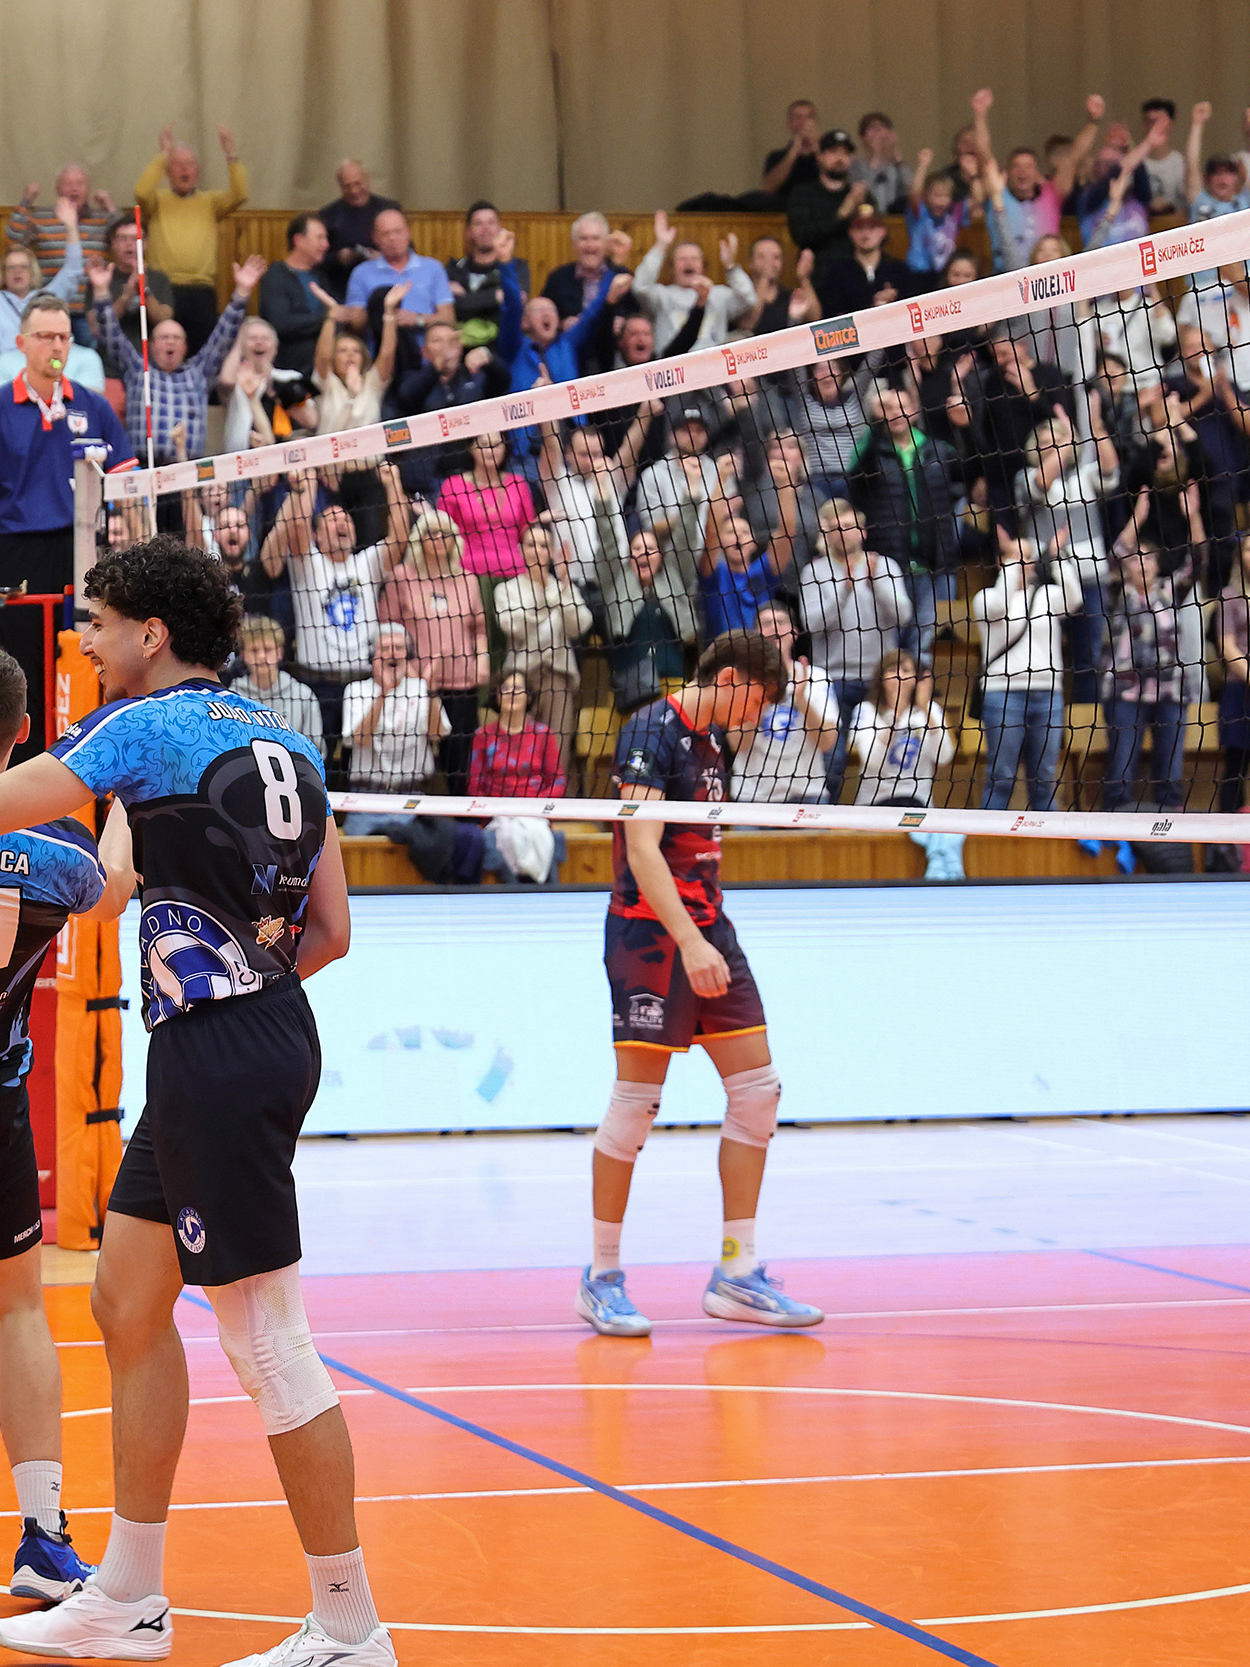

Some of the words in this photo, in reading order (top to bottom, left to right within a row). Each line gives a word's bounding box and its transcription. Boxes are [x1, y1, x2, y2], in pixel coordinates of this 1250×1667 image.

[1158, 243, 1188, 262] SKUPINA
[1189, 237, 1205, 254] ČEZ
[1031, 270, 1075, 301] VOLEJ.TV
[924, 304, 949, 321] SKUPINA
[950, 300, 961, 315] ČEZ
[653, 366, 684, 390] VOLEJ.TV
[251, 740, 302, 840] 8
